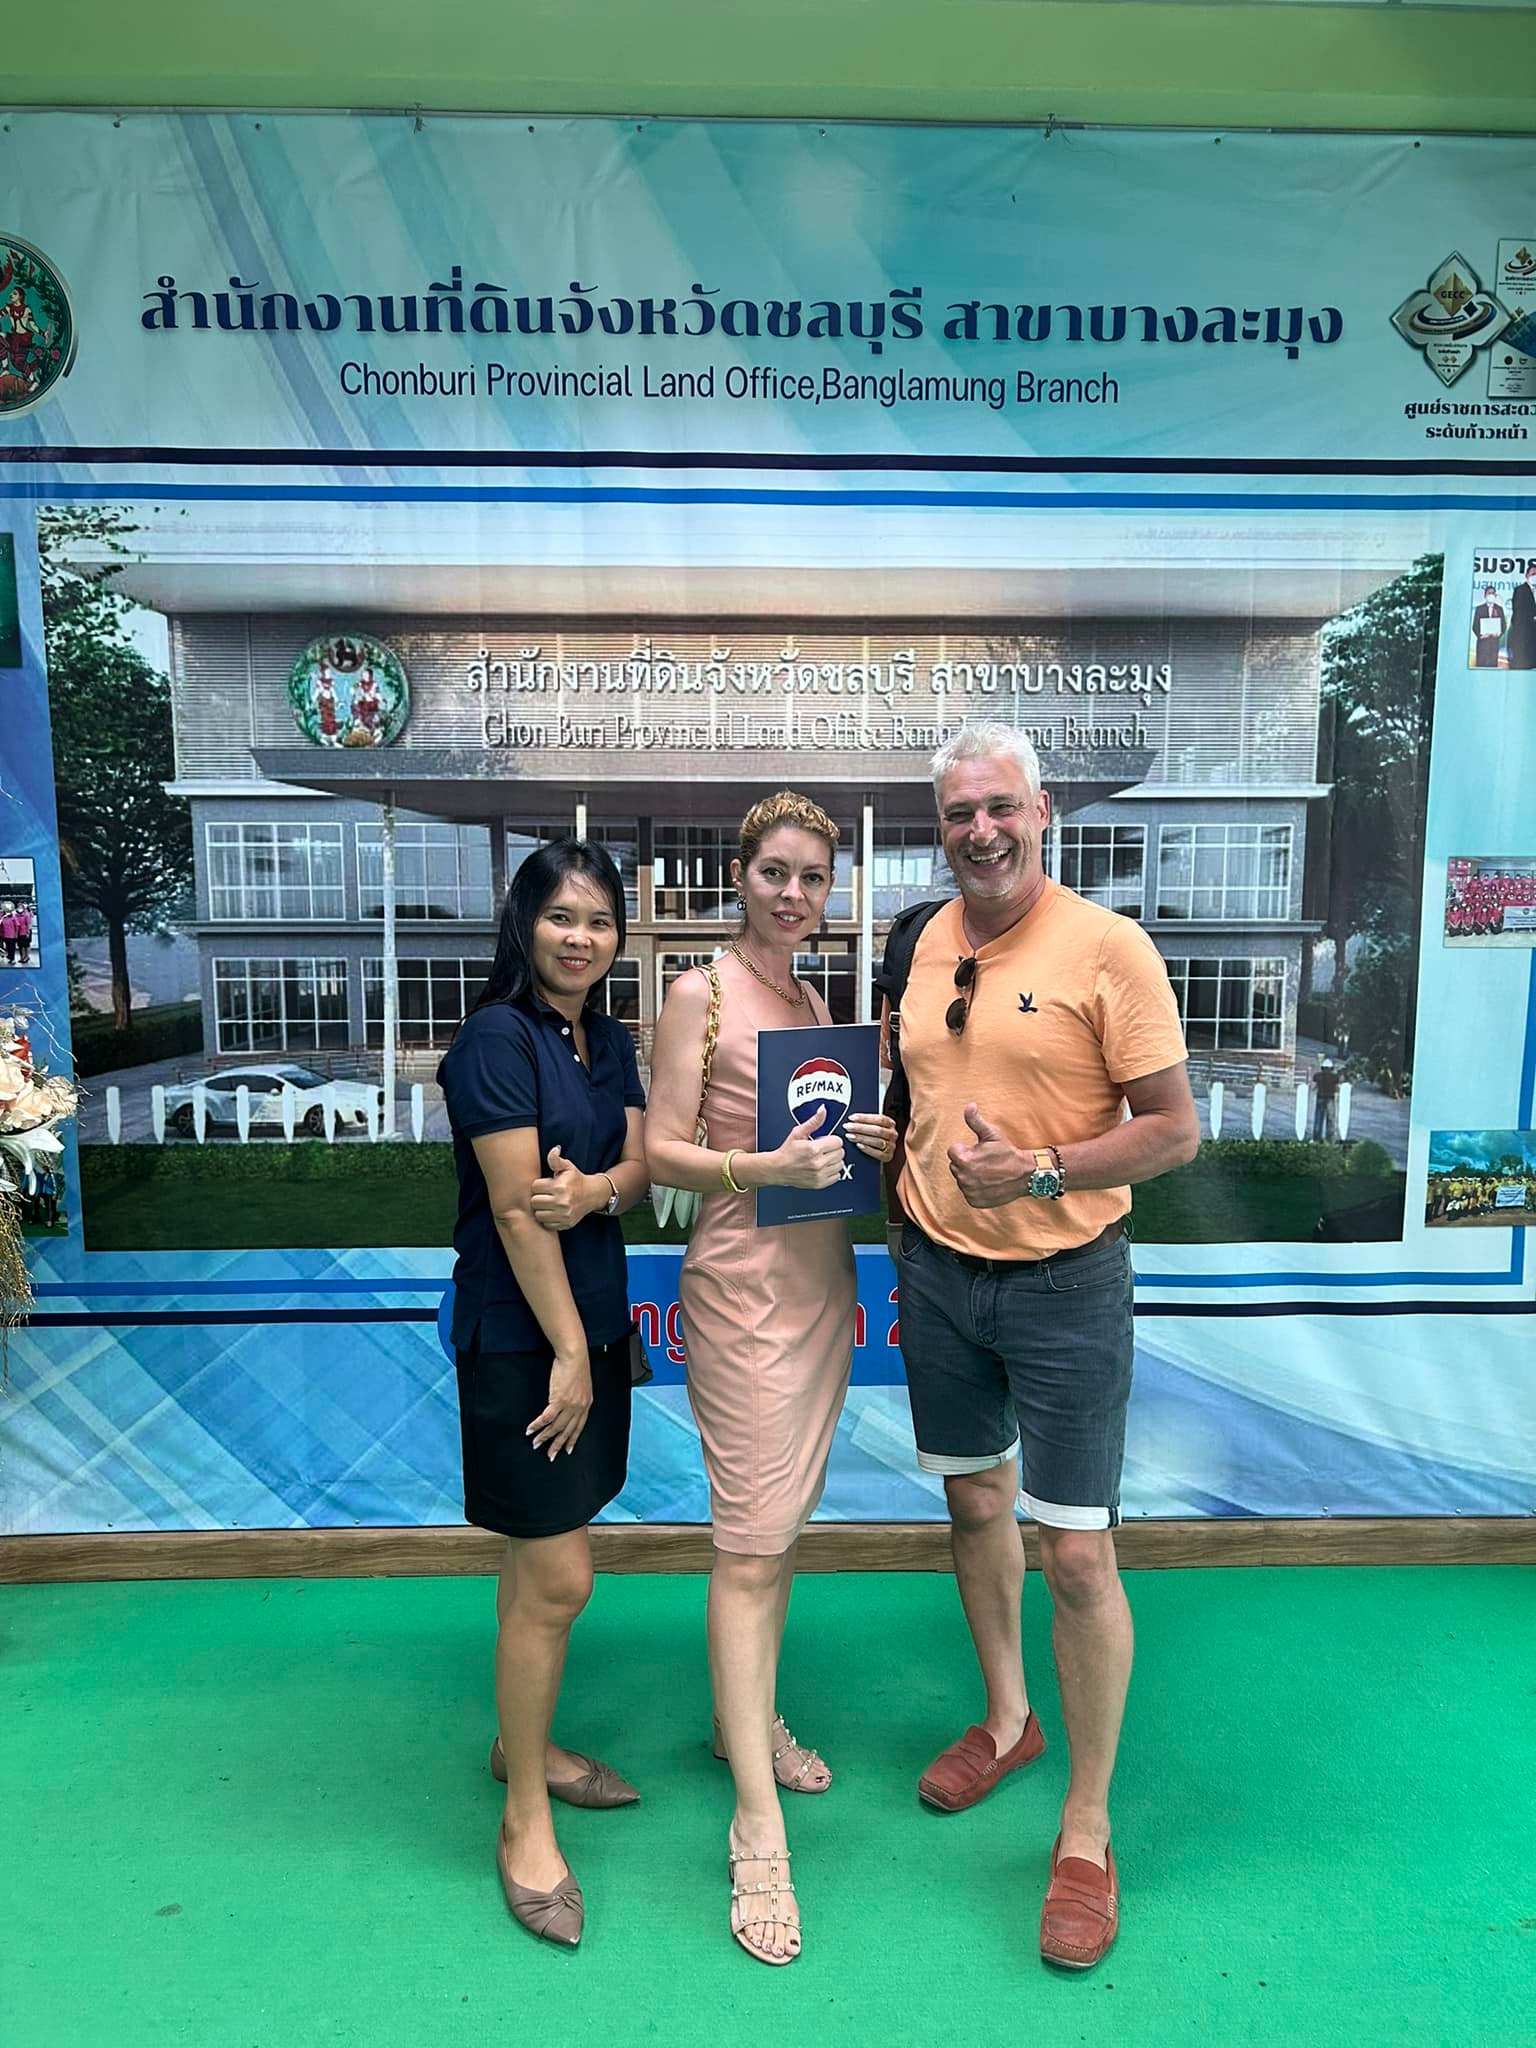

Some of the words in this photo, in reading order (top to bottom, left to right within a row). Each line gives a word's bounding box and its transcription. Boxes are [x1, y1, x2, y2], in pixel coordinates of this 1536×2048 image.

[140, 265, 925, 356] สำนักงานที่ดินจังหวัดชลบุรี
[943, 300, 1344, 361] สาขาบางละมุง
[1440, 290, 1465, 300] GECC
[340, 361, 477, 396] Chonburi
[486, 363, 634, 398] Provincial
[643, 365, 714, 398] Land
[1016, 370, 1119, 404] Branch
[1425, 422, 1529, 440] ระดับก้าวหน้า
[466, 638, 917, 705] สำนักงานที่ดินจังหวัดชลบุรี
[930, 660, 1172, 705] สาขาบางละมุง
[482, 707, 549, 749] Chon
[558, 713, 607, 749] Buri
[614, 712, 734, 749] Provincial
[740, 711, 801, 749] Land
[811, 711, 884, 750] Office
[1062, 711, 1150, 750] Branch
[796, 1080, 845, 1098] RE/MAX
